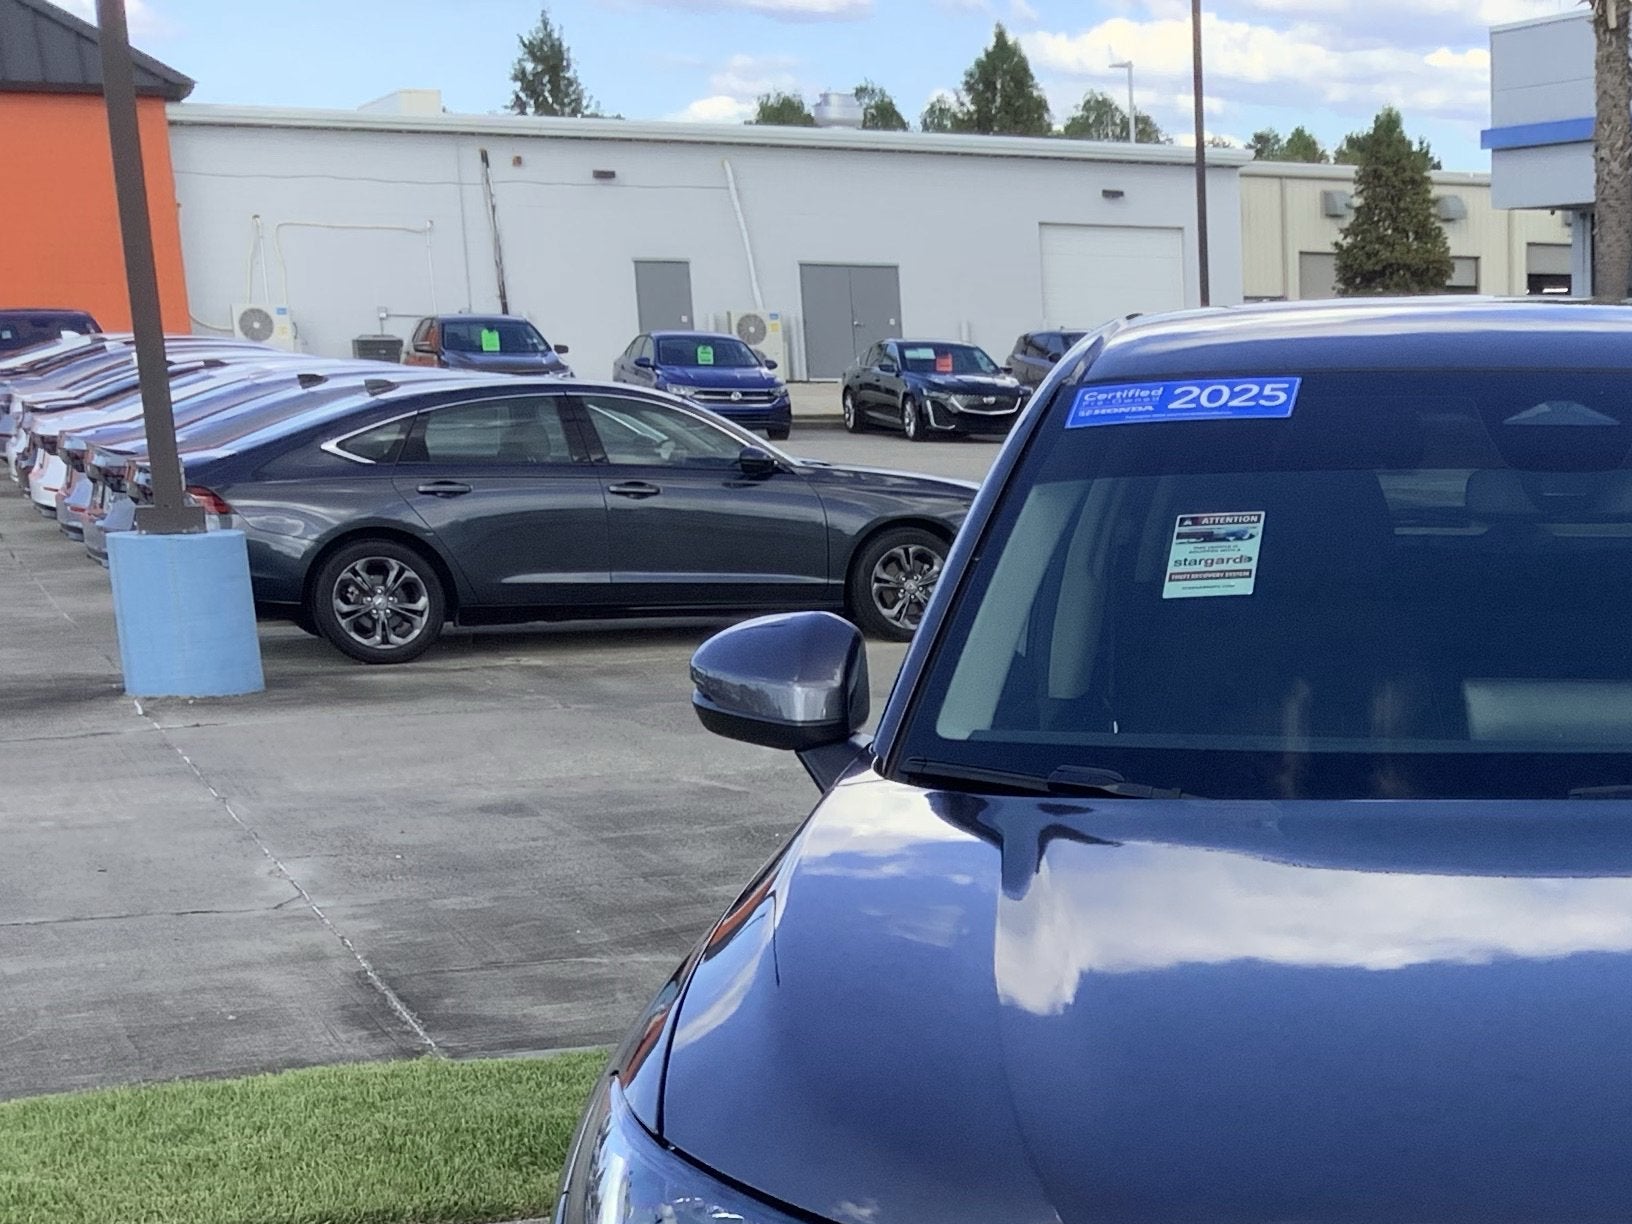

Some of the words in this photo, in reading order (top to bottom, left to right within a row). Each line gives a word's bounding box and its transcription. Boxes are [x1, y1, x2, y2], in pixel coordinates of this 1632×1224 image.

[1084, 386, 1164, 400] Certified
[1167, 383, 1290, 410] 2025
[1093, 405, 1154, 415] HONDA
[1201, 515, 1258, 525] ATTENTION
